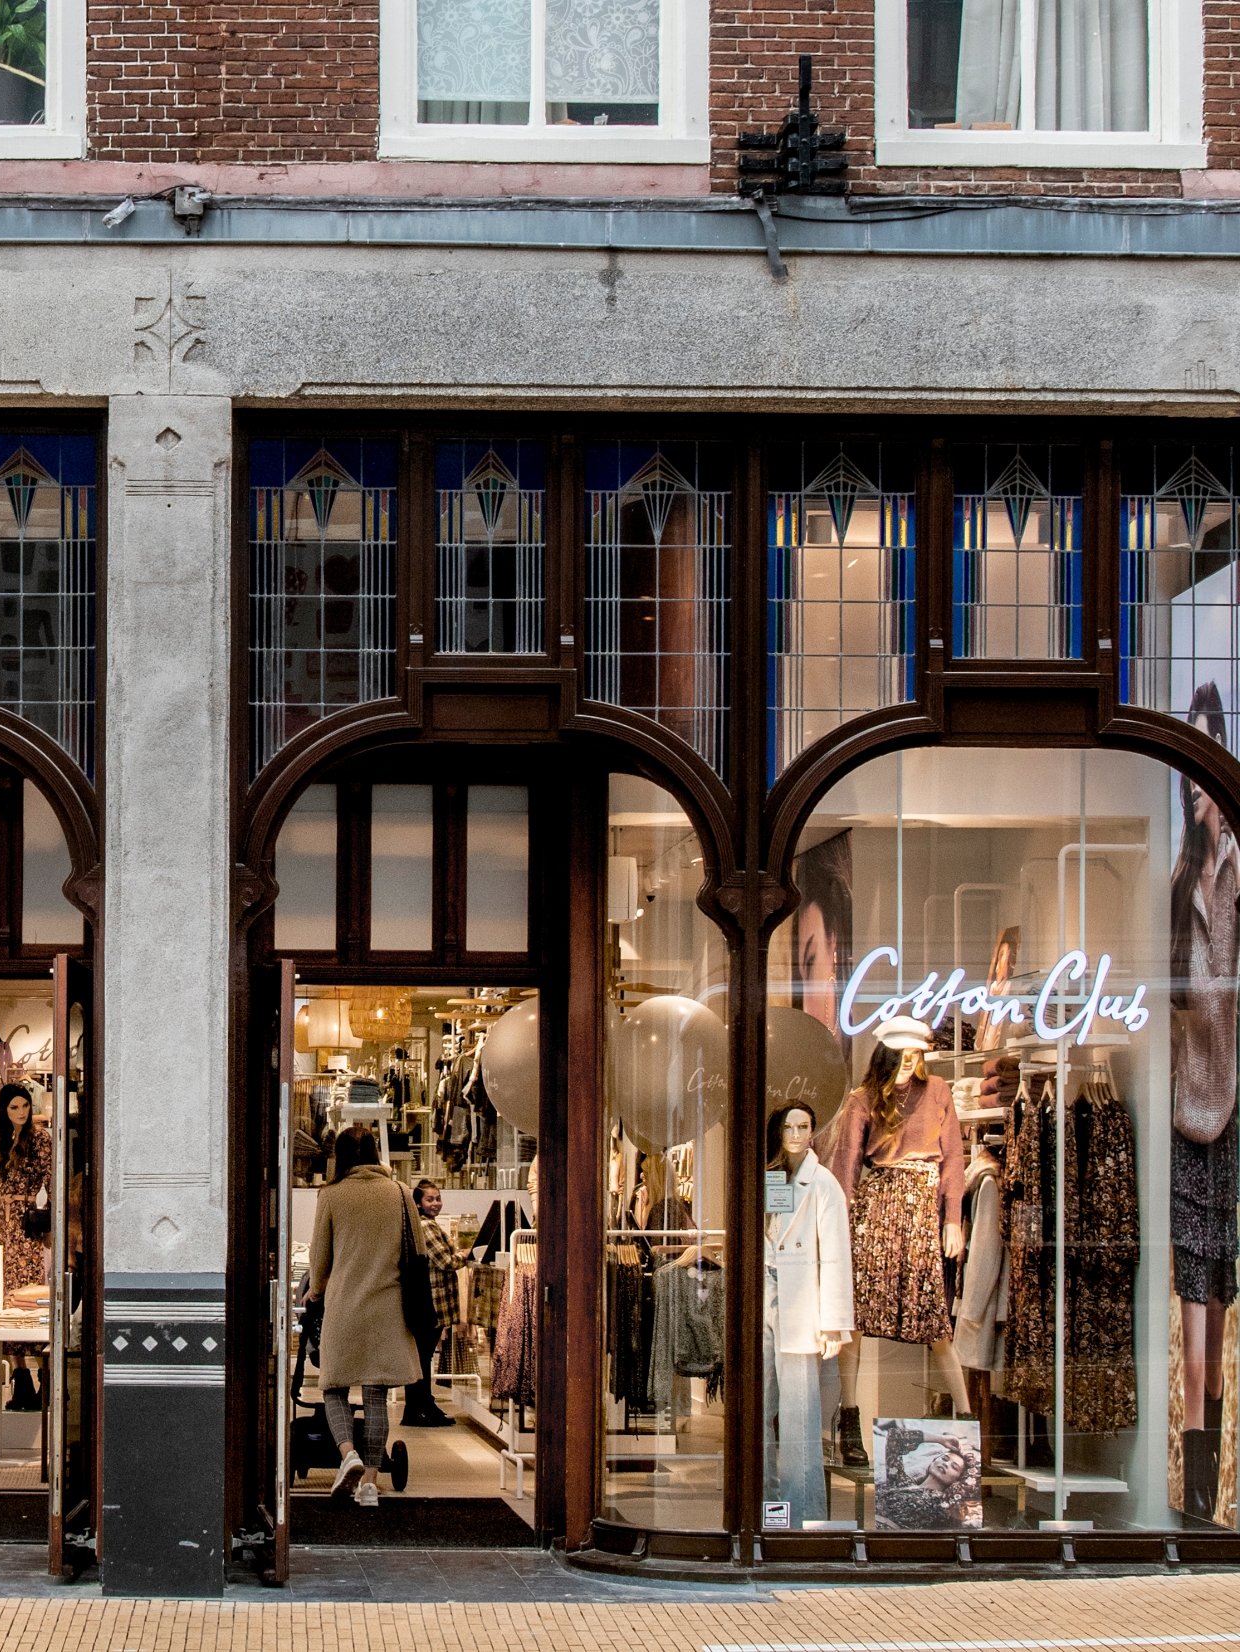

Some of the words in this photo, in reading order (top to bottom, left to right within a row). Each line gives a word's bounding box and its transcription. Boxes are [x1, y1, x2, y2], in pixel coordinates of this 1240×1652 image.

[839, 946, 1025, 1036] Cotton
[1034, 950, 1149, 1045] Club
[785, 1075, 817, 1100] Club
